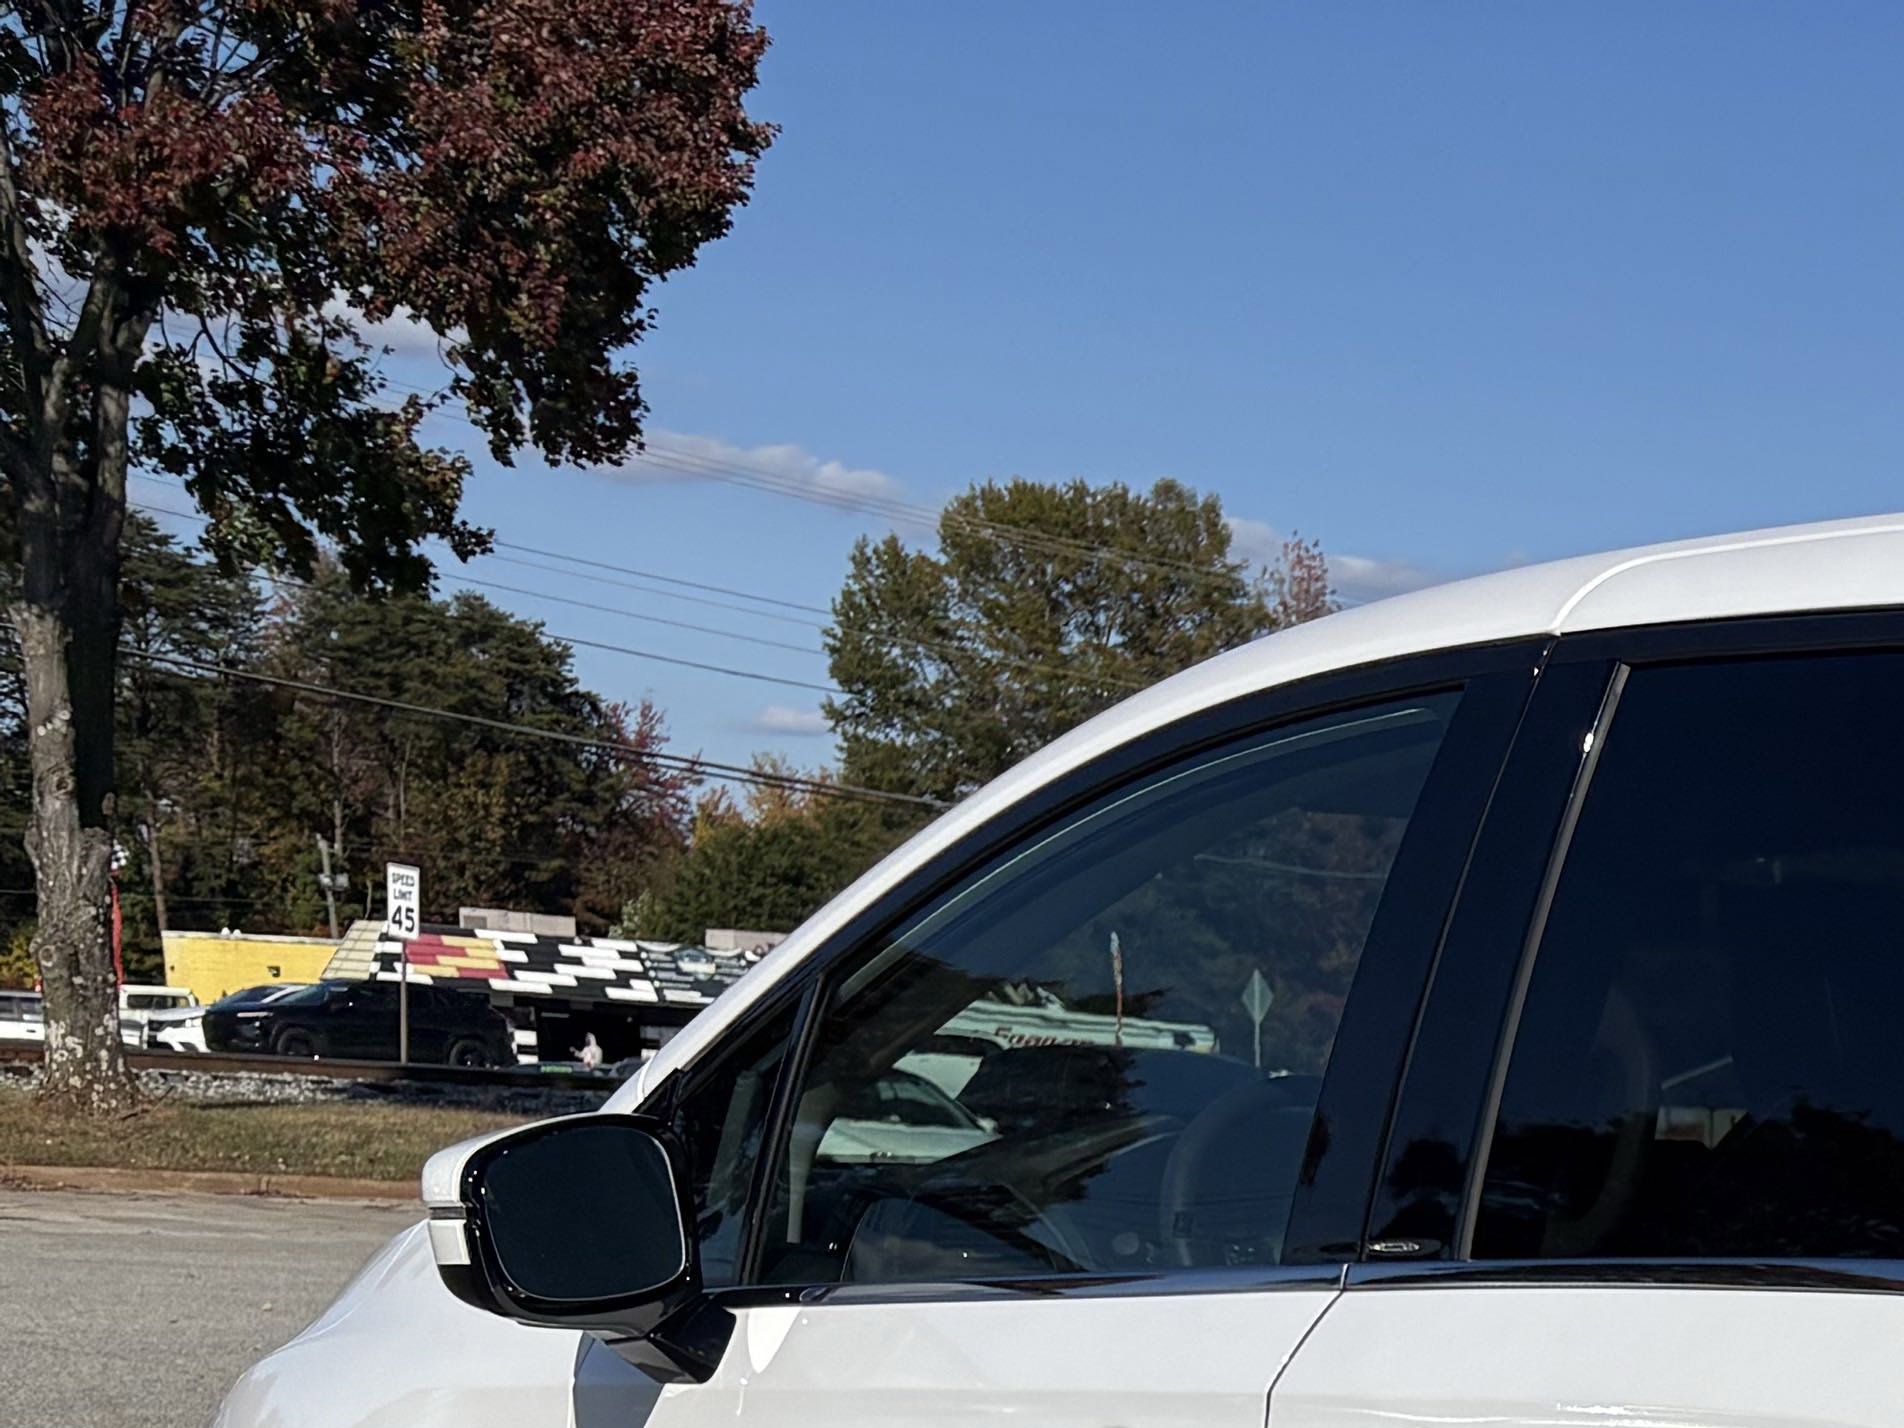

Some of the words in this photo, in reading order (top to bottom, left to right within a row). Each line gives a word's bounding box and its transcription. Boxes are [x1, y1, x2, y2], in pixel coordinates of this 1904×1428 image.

[391, 872, 415, 887] SPEED
[393, 888, 412, 902] LIMIT
[391, 905, 415, 933] 45
